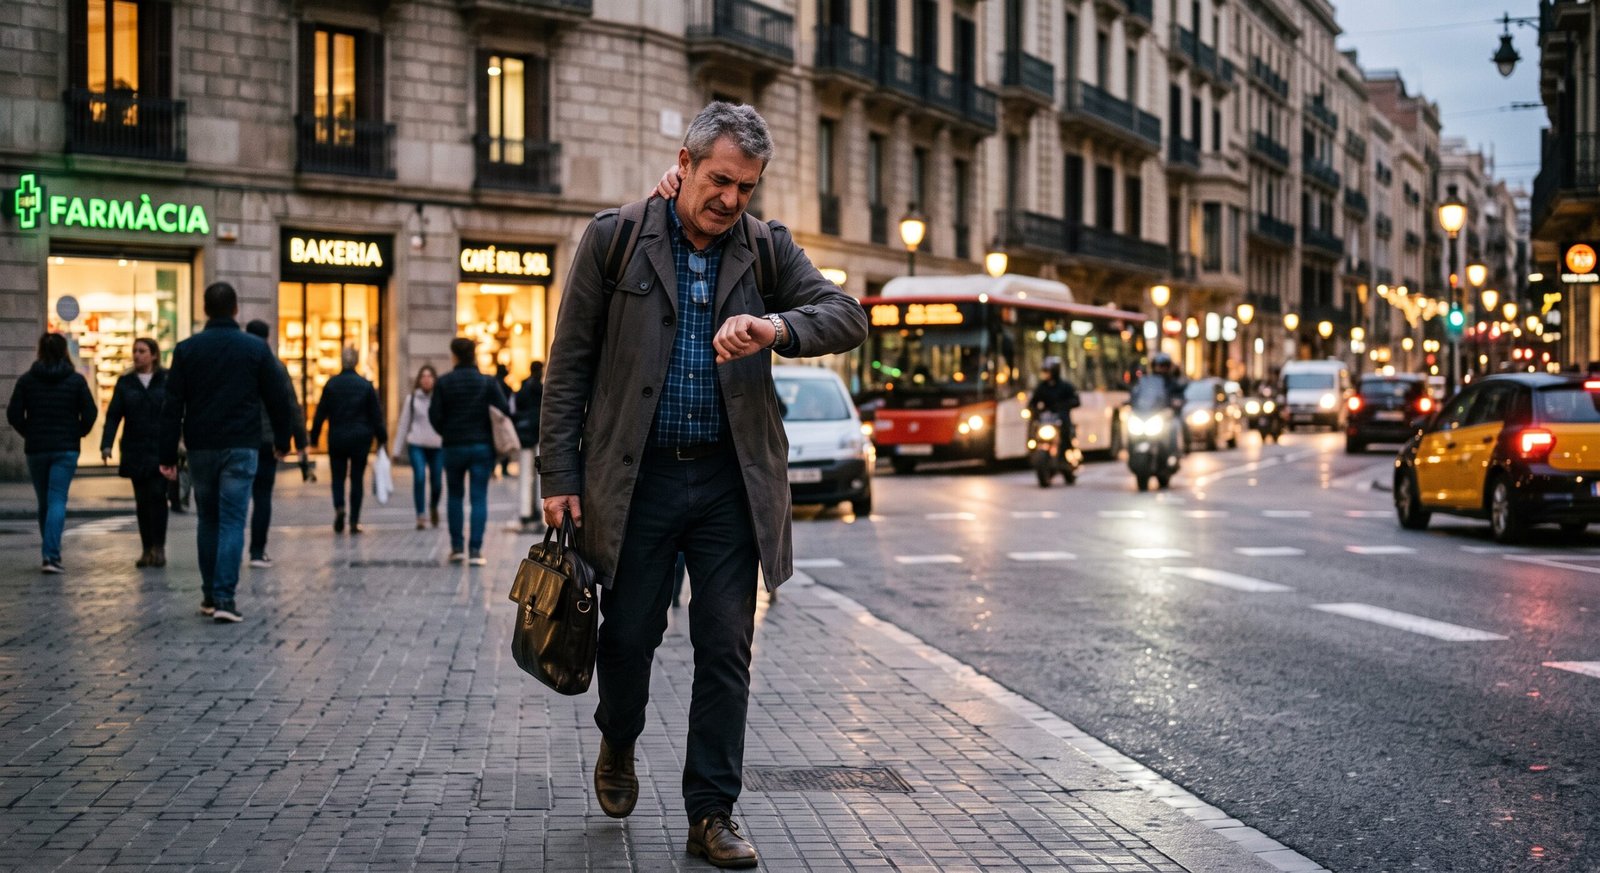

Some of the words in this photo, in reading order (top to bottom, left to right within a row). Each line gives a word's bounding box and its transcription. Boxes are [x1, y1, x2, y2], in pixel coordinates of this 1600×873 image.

[50, 194, 209, 233] FARMÀCIA
[290, 237, 383, 267] BAKERIA
[460, 245, 496, 272] CAFÉ
[496, 250, 523, 274] DEL
[523, 252, 551, 275] SOL
